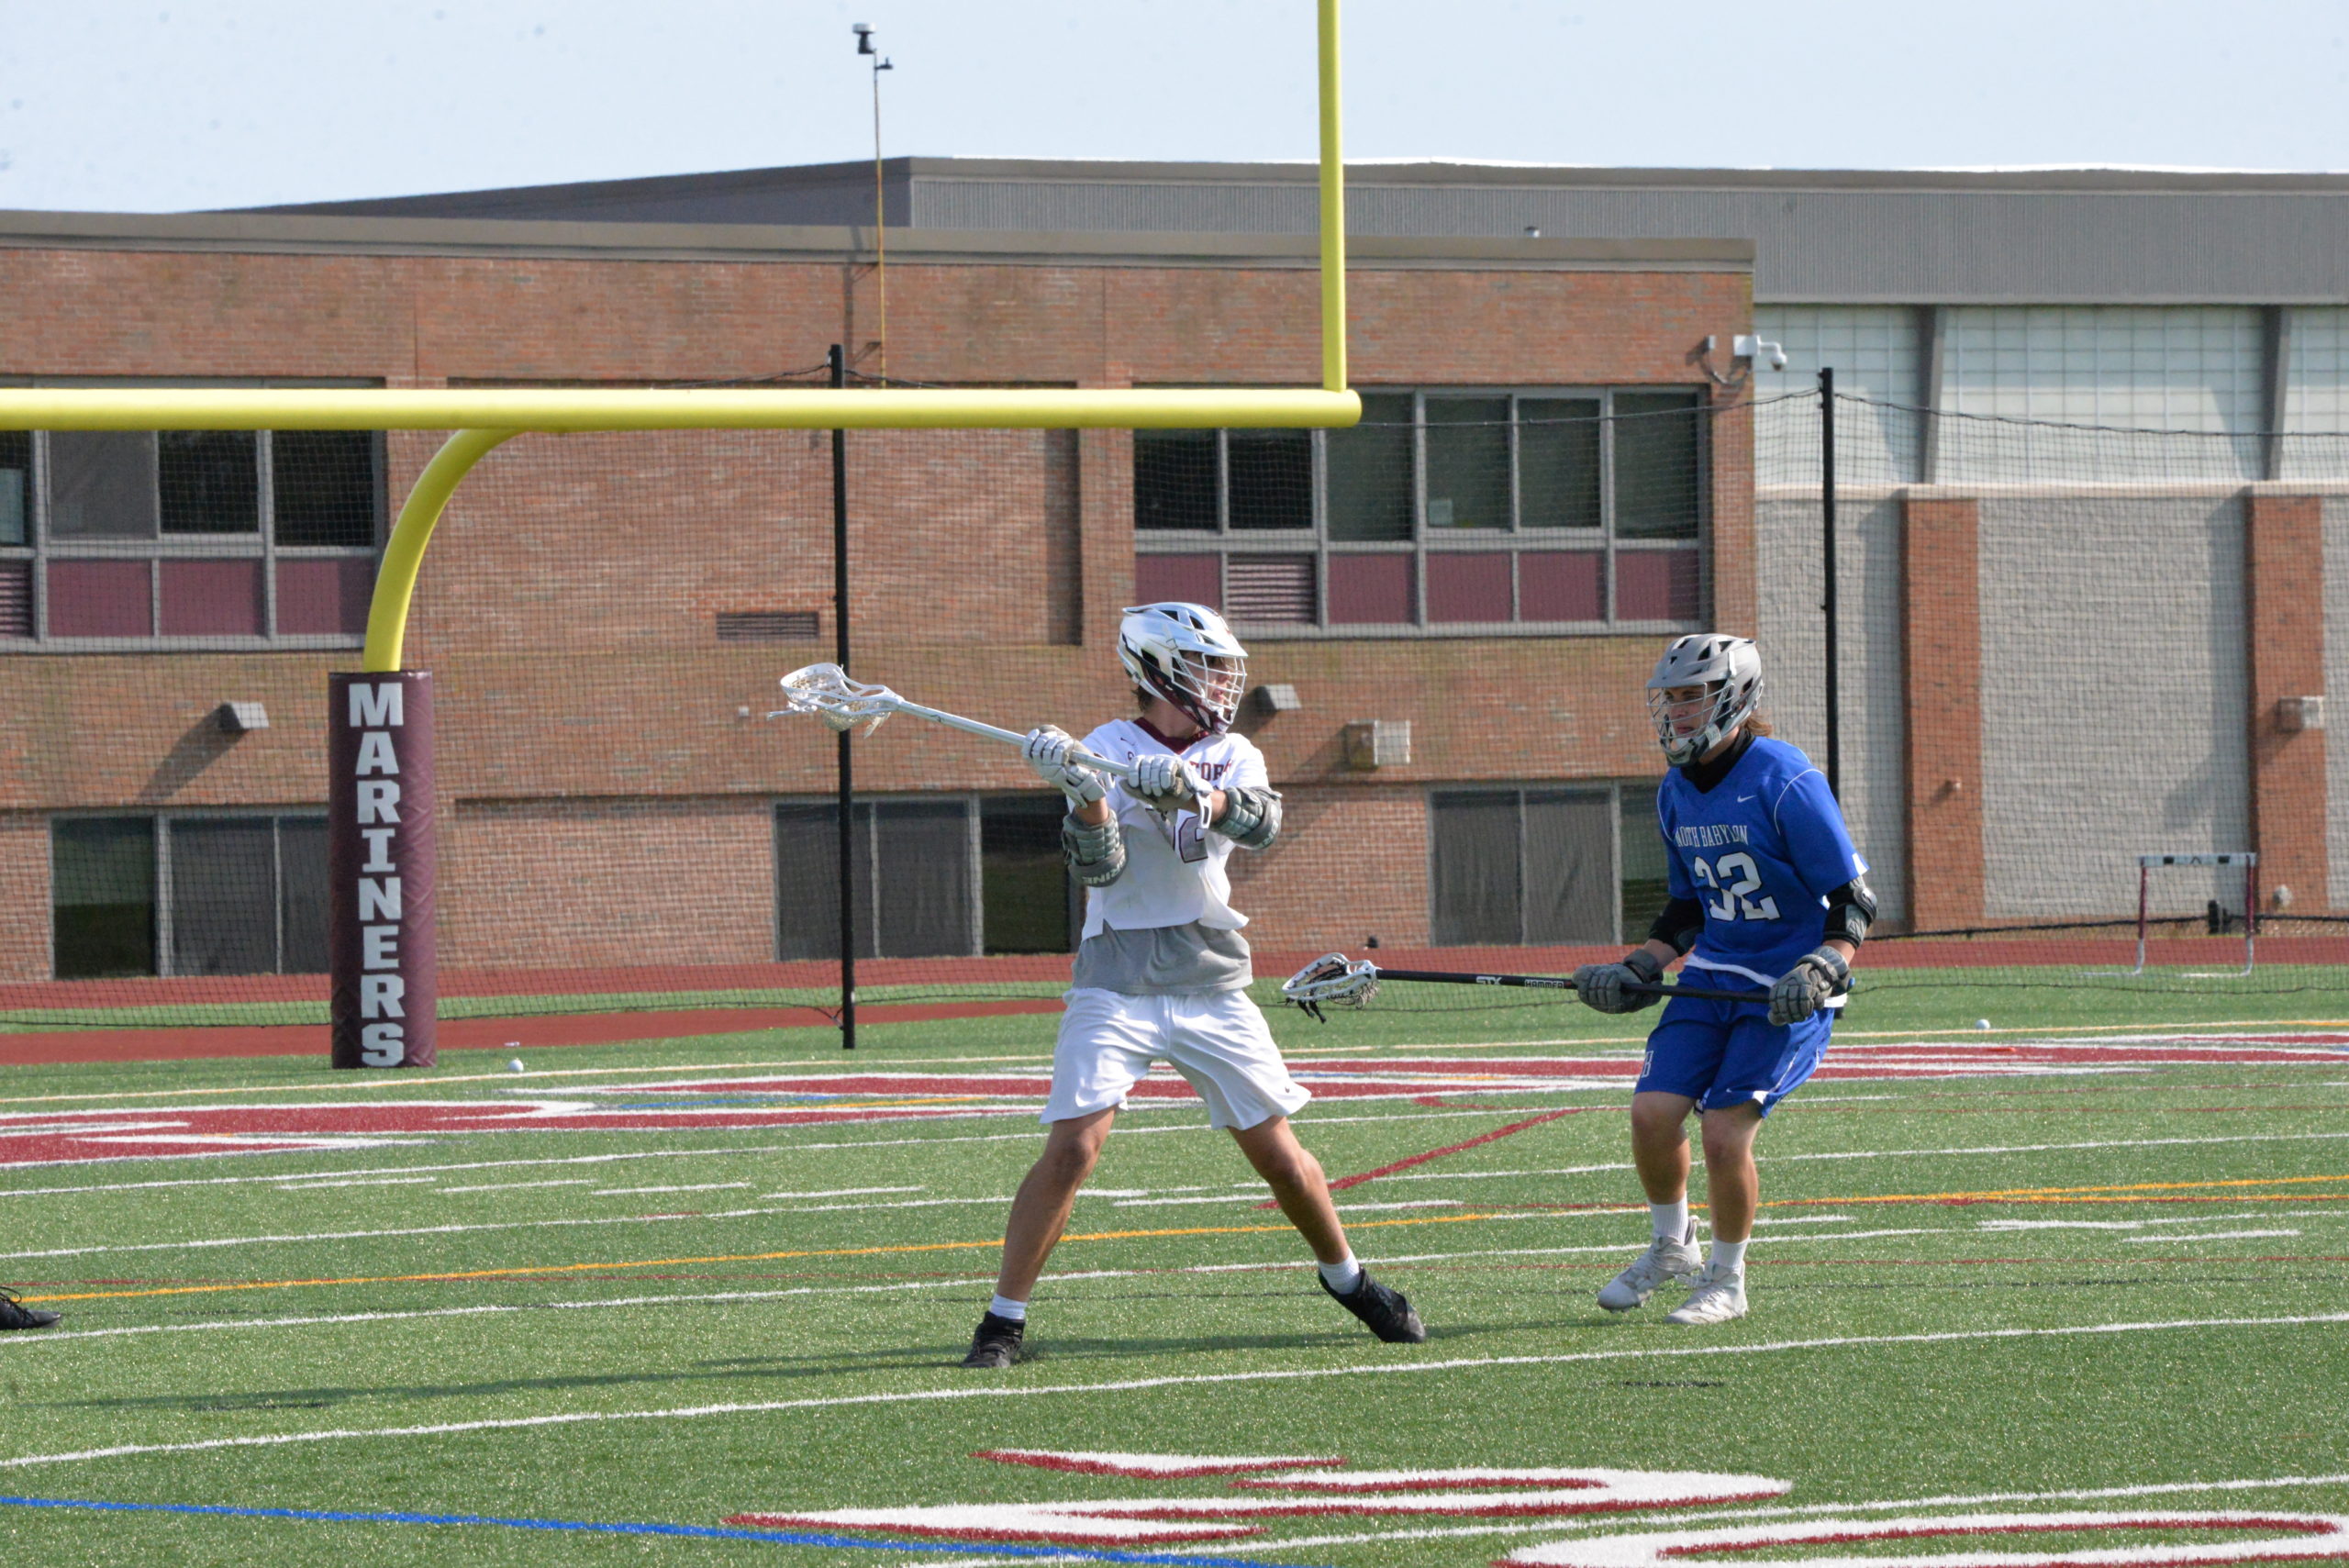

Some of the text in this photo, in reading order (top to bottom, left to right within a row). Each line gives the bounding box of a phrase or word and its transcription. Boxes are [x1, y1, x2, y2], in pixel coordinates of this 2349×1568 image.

[348, 682, 406, 1068] MARINERS
[1695, 851, 1781, 921] 32
[1475, 975, 1503, 986] STX
